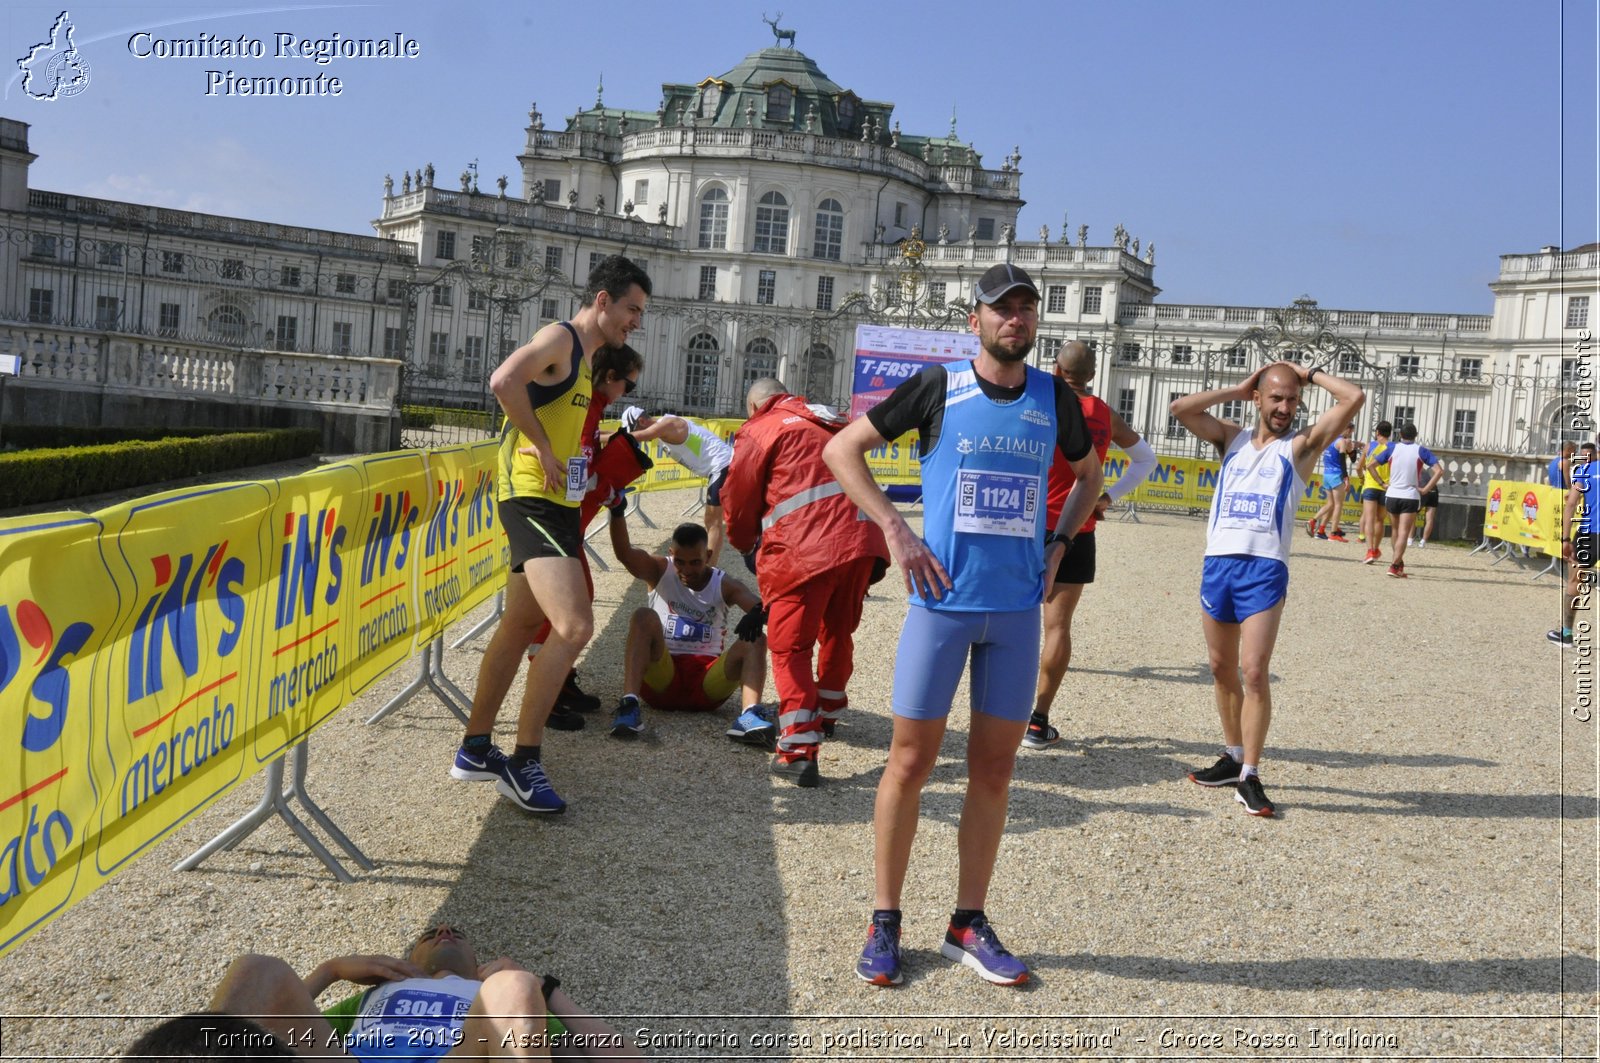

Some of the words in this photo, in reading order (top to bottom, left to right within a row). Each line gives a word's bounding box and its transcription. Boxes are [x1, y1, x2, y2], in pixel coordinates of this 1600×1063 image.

[979, 436, 1047, 457] AZIMUT
[425, 479, 465, 559] iN's
[981, 487, 1020, 510] 1124
[1147, 487, 1184, 500] mercato
[1233, 498, 1258, 514] 386
[361, 490, 419, 587] iN's
[275, 508, 347, 630] iN's
[424, 568, 461, 620] mercato
[127, 539, 246, 705] iN's
[358, 600, 408, 656] mercato
[268, 642, 339, 721] mercato
[121, 693, 235, 819] mercato
[394, 999, 444, 1016] 304
